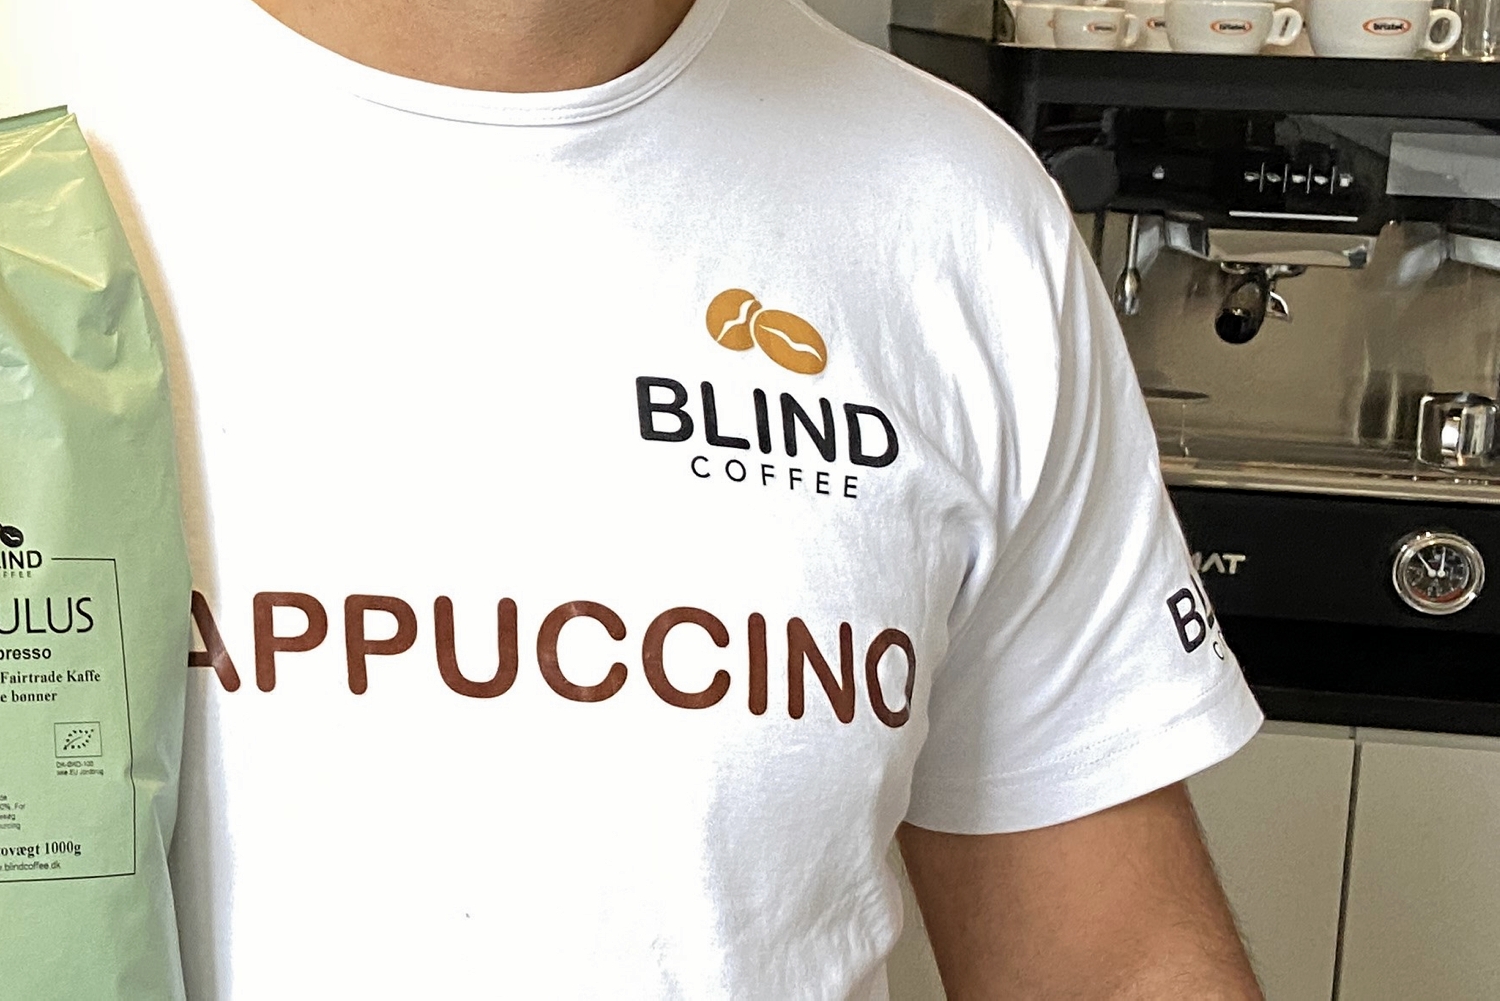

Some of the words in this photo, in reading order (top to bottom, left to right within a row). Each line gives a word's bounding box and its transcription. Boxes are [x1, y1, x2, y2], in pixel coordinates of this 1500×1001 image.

[636, 376, 899, 468] BLIND
[691, 456, 858, 499] COFFEE
[0, 671, 63, 684] Fairtrade
[66, 670, 101, 683] Kaffe
[11, 689, 57, 703] bønner
[45, 841, 82, 856] 1000g
